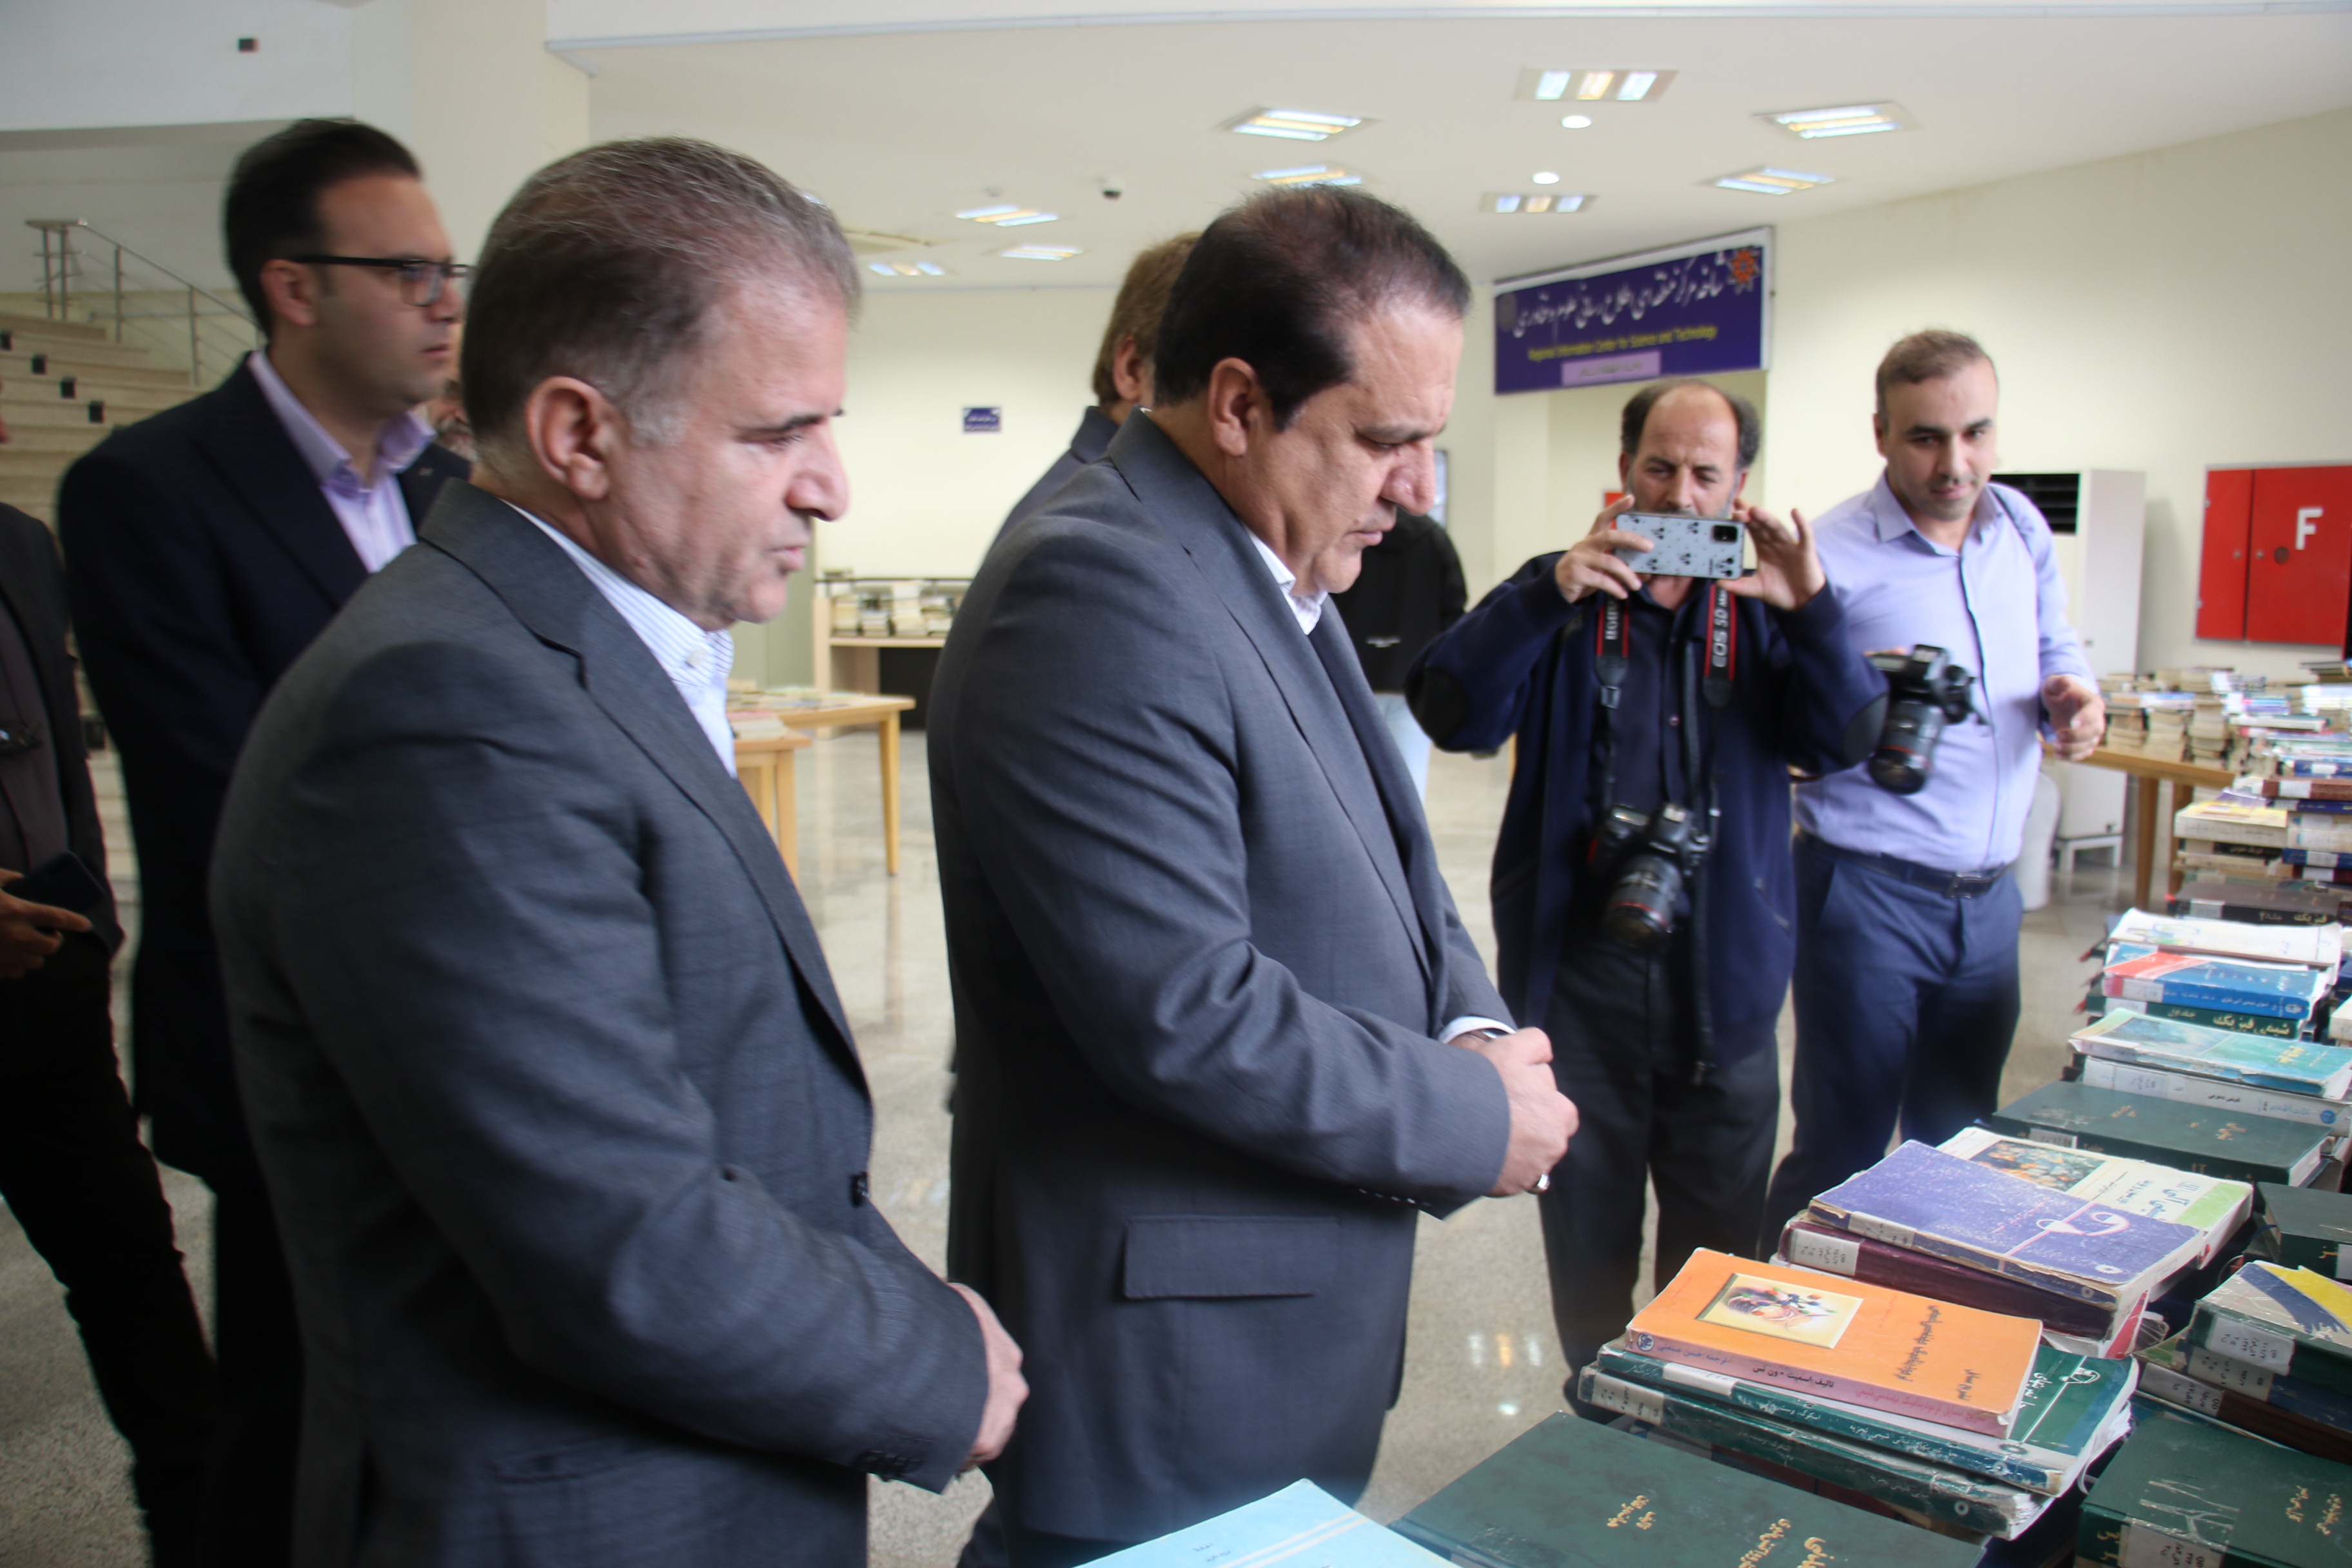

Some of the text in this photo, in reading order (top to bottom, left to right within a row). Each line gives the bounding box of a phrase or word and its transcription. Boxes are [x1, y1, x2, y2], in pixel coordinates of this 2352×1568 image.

[1630, 333, 1657, 348] Science
[1658, 331, 1672, 344] and
[1674, 325, 1717, 341] Technology
[2295, 506, 2323, 550] F
[1605, 598, 1619, 640] anon
[1712, 630, 1728, 668] EOS
[2213, 1015, 2255, 1031] فیزیک
